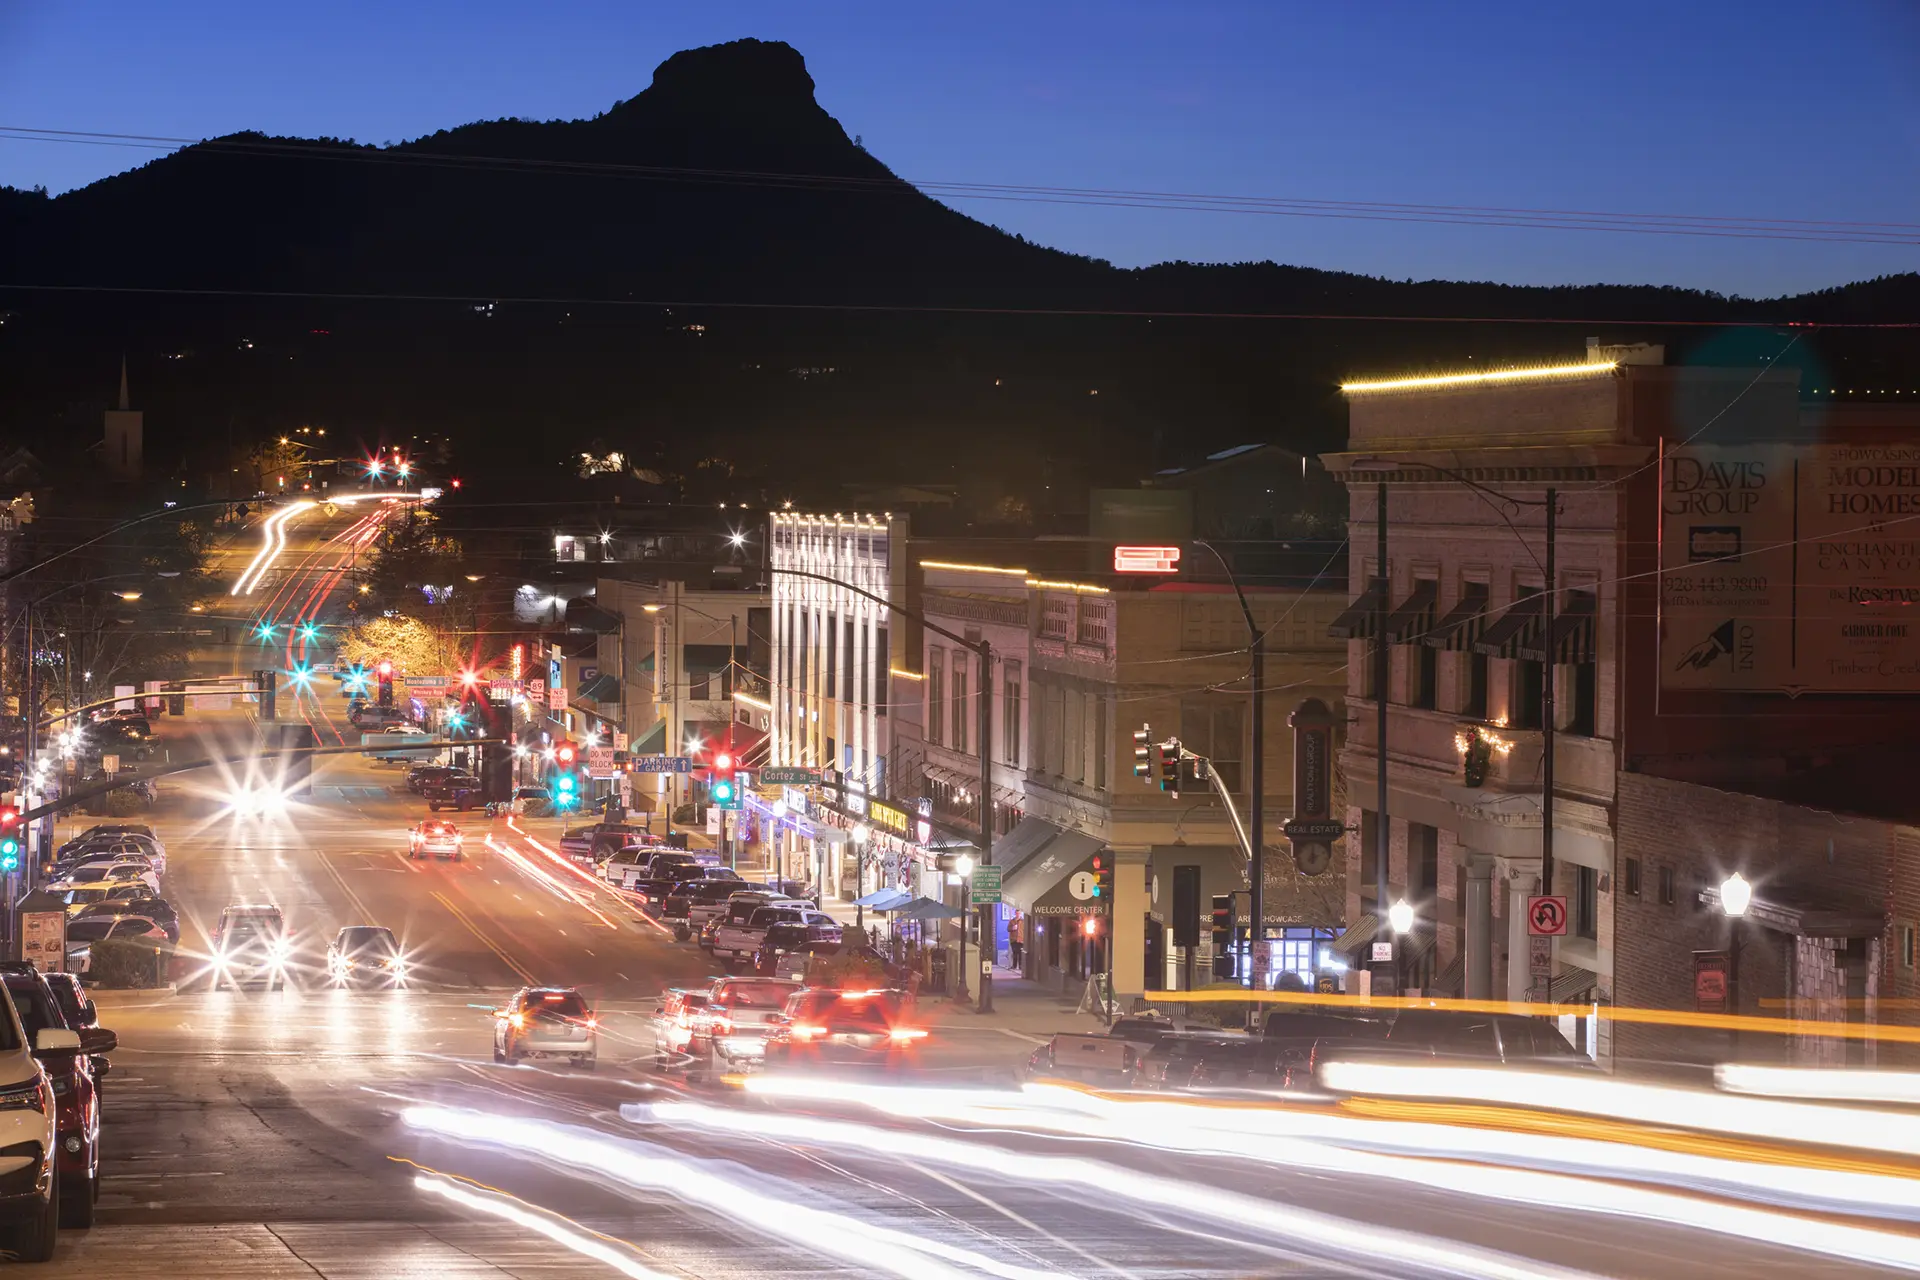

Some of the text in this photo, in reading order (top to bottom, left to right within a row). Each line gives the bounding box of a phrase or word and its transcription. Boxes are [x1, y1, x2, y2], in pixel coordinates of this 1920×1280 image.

[1669, 457, 1766, 493] DAVIS
[1828, 466, 1920, 487] MODEL
[1663, 481, 1759, 517] GROUP
[1865, 519, 1886, 532] AT
[1818, 556, 1920, 570] CANYO
[1664, 576, 1767, 592] 928.443.9800
[1847, 585, 1920, 605] Reserve
[1740, 625, 1754, 670] INFO
[1826, 658, 1875, 675] Timber
[590, 750, 613, 758] DO NOT
[635, 758, 677, 772] PARKING
[764, 770, 795, 781] Cortez
[799, 773, 806, 781] St
[1287, 825, 1341, 834] REAL ESTATE
[1034, 905, 1103, 914] WELCOME CENTER
